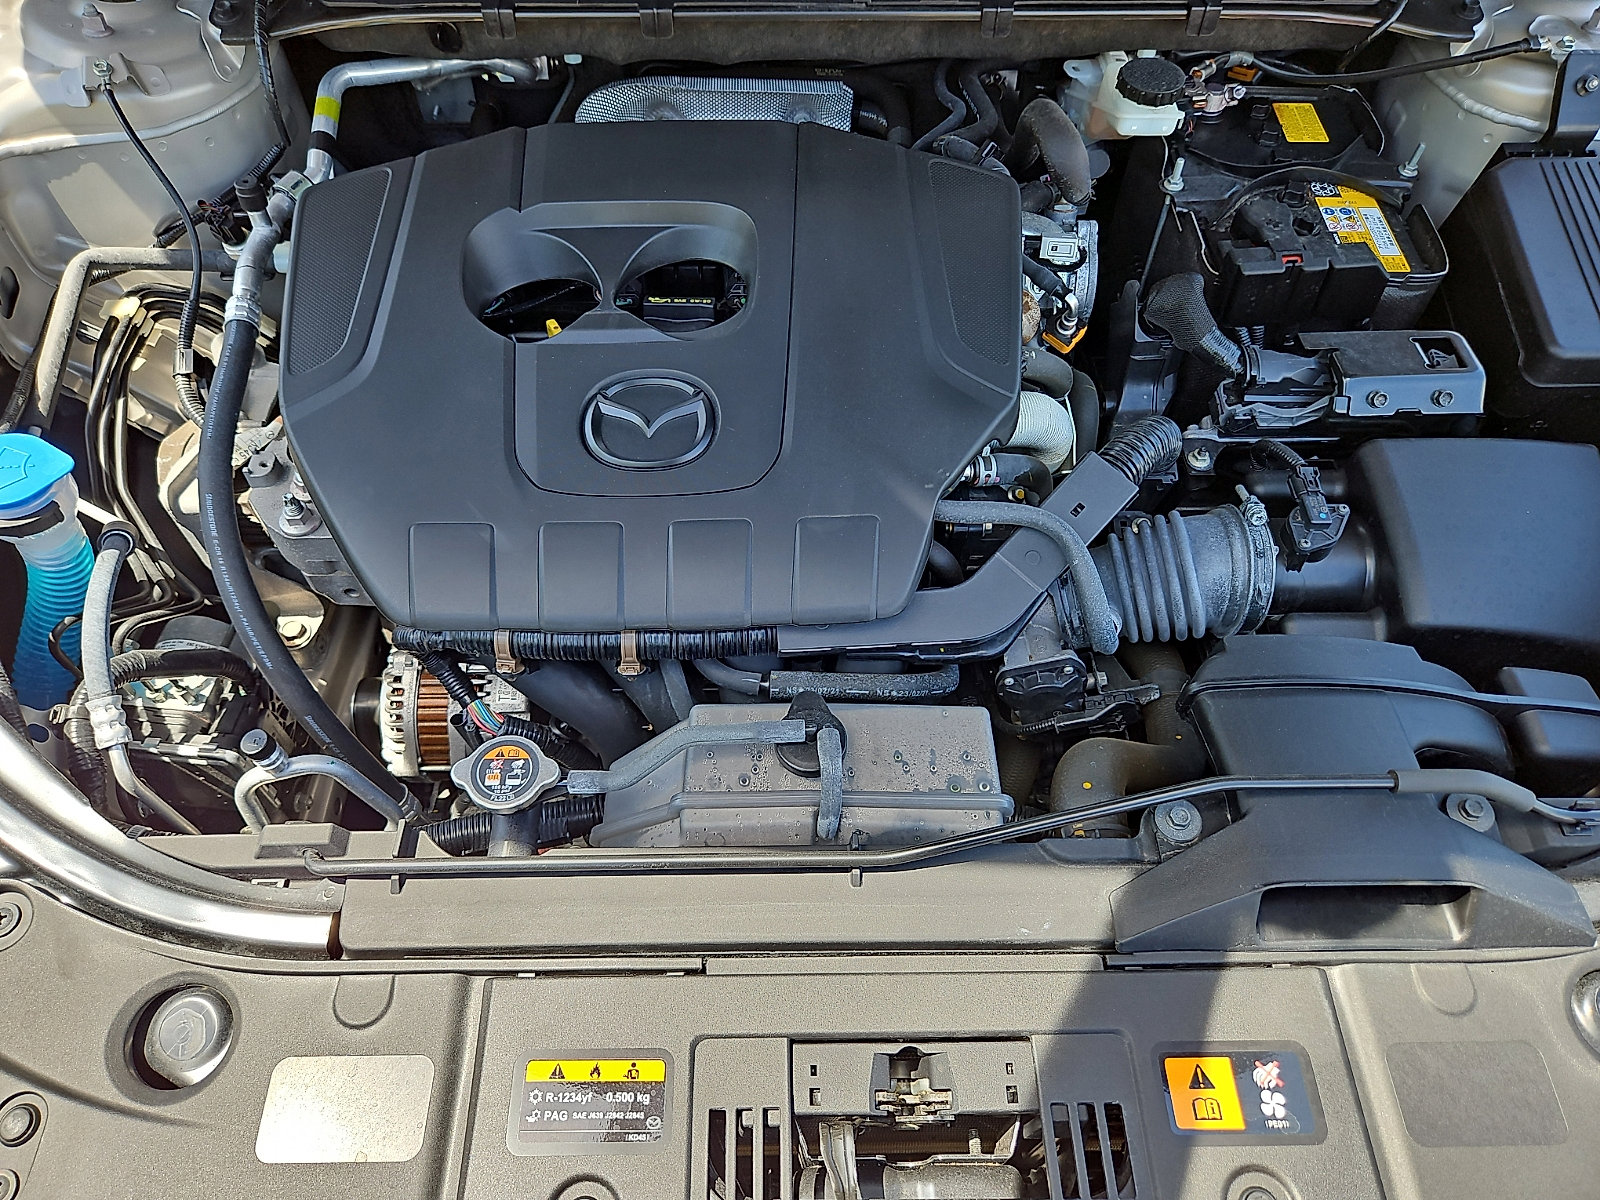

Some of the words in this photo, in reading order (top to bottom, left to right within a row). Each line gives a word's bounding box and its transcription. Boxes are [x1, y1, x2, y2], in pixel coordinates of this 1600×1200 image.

[545, 1092, 593, 1104] R-1234yf
[606, 1092, 634, 1103] 0.500
[636, 1092, 651, 1105] kg
[543, 1111, 568, 1121] PAG
[572, 1111, 587, 1119] SAE
[587, 1111, 604, 1119] J639
